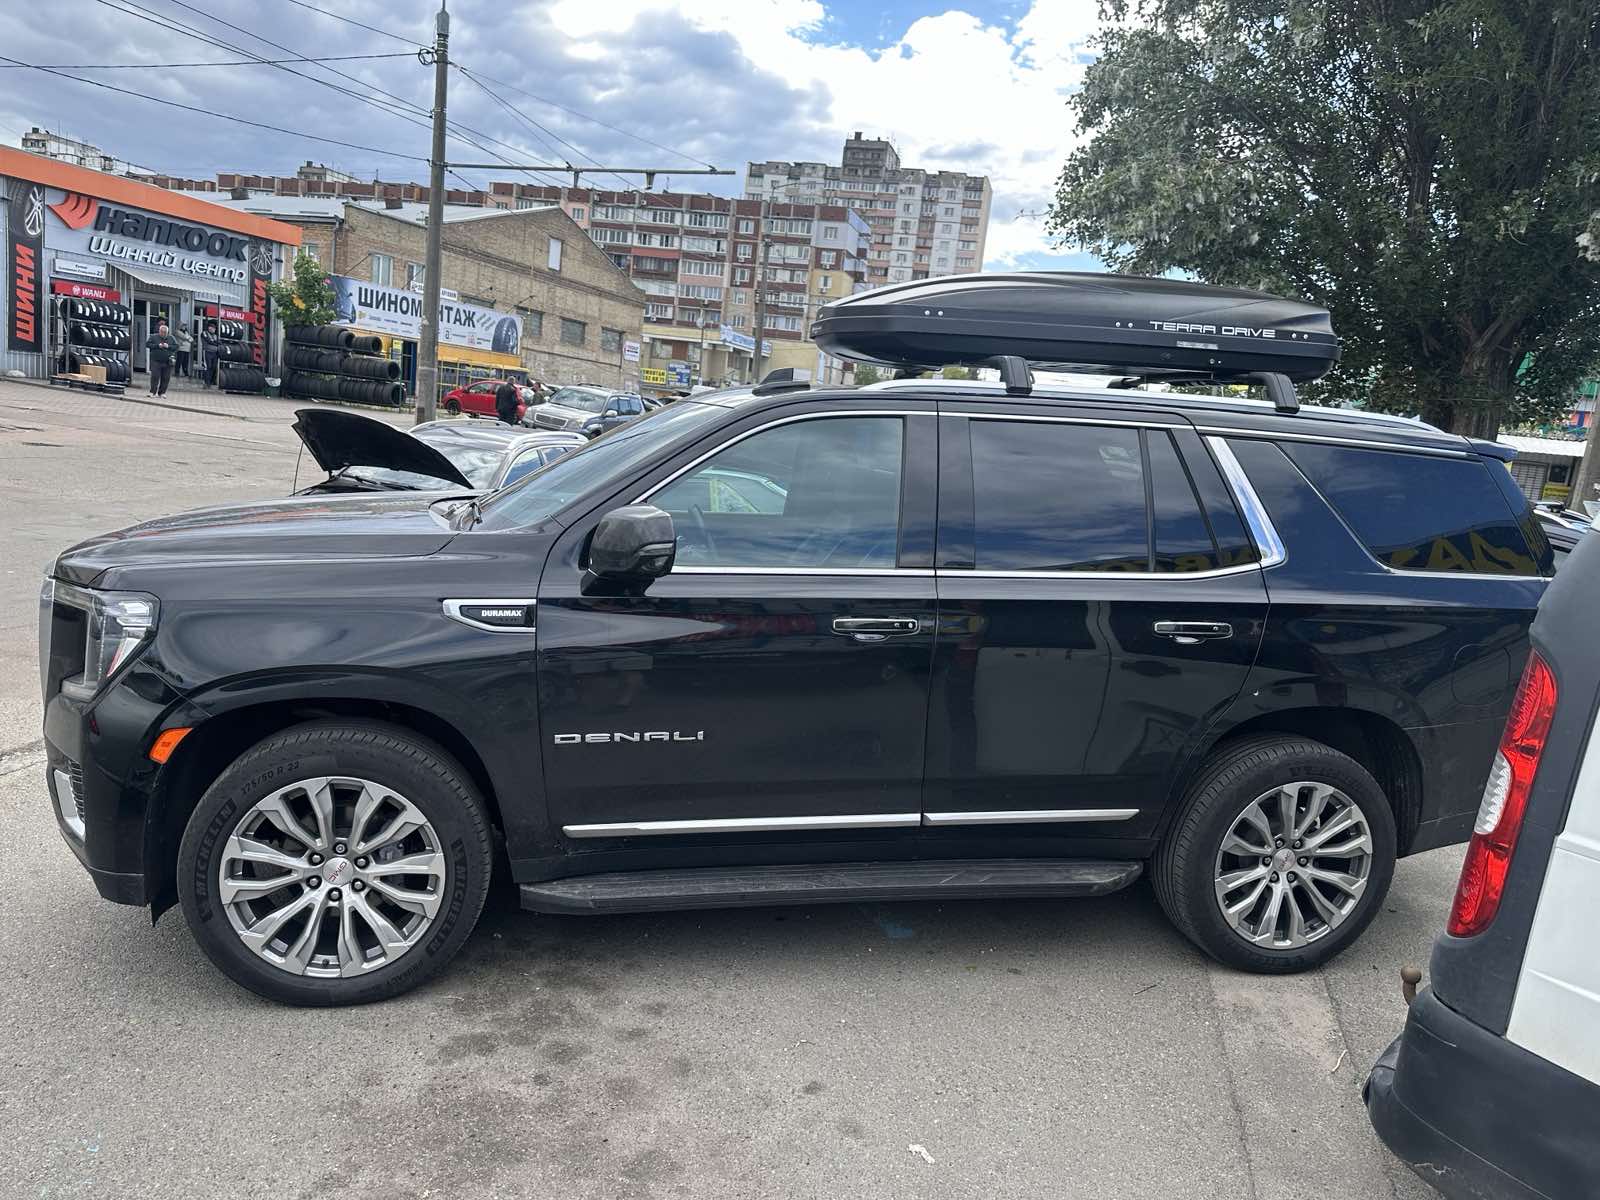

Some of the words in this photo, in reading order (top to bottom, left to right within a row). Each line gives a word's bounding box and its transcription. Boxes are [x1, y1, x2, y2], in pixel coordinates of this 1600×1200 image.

[90, 236, 177, 268] Шинний
[183, 257, 246, 283] центр
[16, 243, 35, 343] ШИНИ
[82, 287, 106, 299] WANLI
[1150, 321, 1216, 334] TERRA
[1221, 326, 1276, 338] DRIVE
[481, 609, 522, 617] DURAMAX
[554, 730, 704, 745] DENALI
